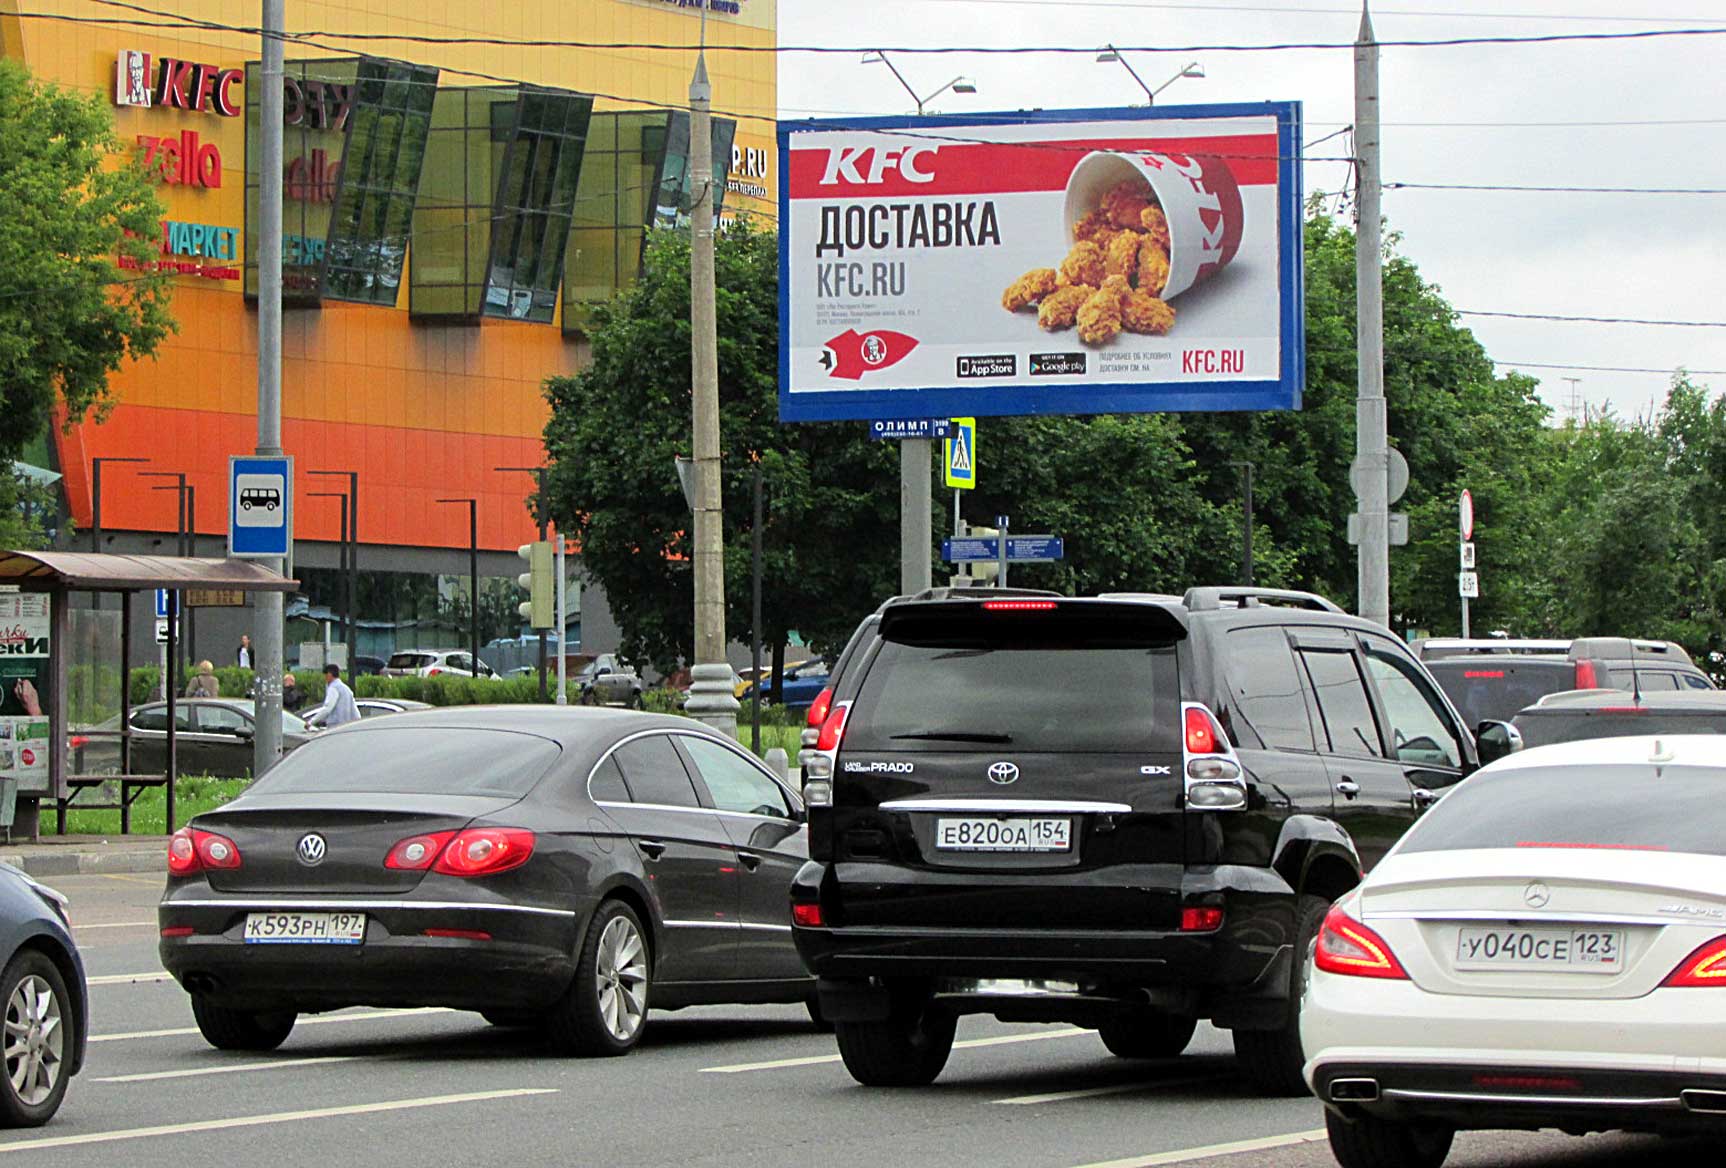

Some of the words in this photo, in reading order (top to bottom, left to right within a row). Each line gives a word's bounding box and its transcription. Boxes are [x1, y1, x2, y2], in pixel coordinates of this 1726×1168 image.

[157, 58, 243, 117] KFC
[819, 145, 938, 185] KFC
[816, 201, 1001, 258] ДОСТАВКА
[817, 262, 905, 298] KFC.RU
[971, 364, 990, 376] App
[991, 363, 1013, 374] Store
[1042, 361, 1070, 374] Google
[1071, 361, 1085, 372] play
[1182, 349, 1244, 374] KFC.RU
[875, 421, 928, 432] ОЛИМП
[871, 762, 914, 773] PRADO
[1140, 765, 1171, 775] GX
[1033, 820, 1064, 838] 154
[331, 915, 359, 930] 197
[1575, 933, 1613, 954] 123
